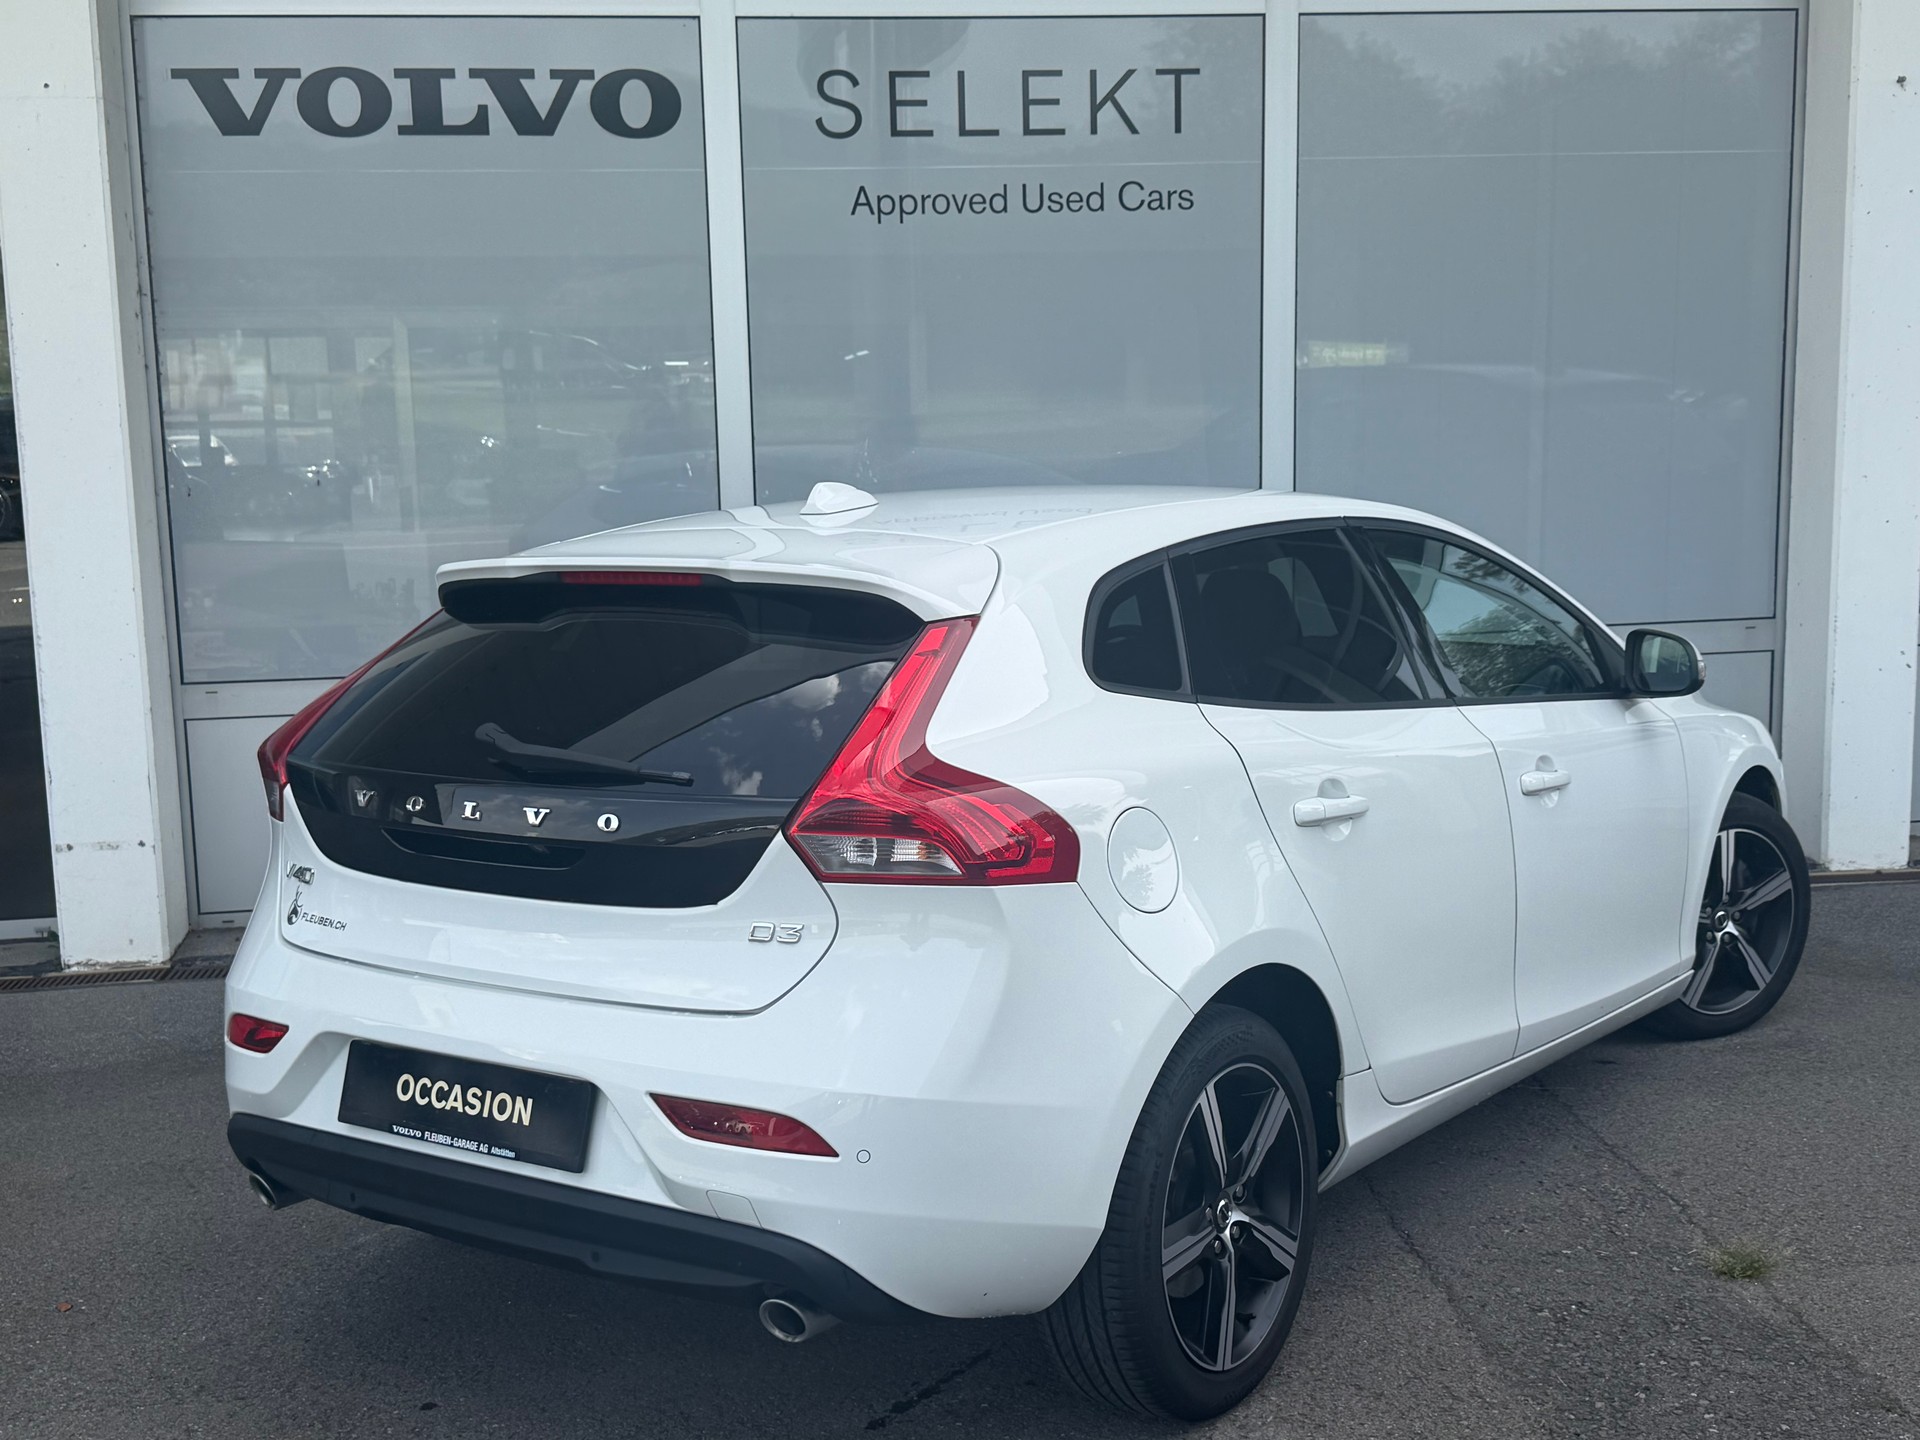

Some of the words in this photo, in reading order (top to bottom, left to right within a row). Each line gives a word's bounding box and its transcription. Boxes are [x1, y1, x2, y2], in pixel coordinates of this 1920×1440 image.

[170, 66, 682, 139] VOLVO
[815, 68, 1200, 139] SELEKT
[851, 184, 1007, 224] Approved
[1021, 183, 1105, 213] Used
[1118, 180, 1194, 212] Cars
[354, 789, 620, 832] VOLVO
[286, 861, 315, 885] V40
[301, 912, 347, 931] FLEUBEN.CH
[748, 921, 803, 945] D3
[396, 1073, 533, 1126] OCCASION
[392, 1124, 422, 1138] VOLVO
[424, 1131, 479, 1151] FLEUBEN-GARAGE
[479, 1143, 489, 1153] AG
[491, 1146, 516, 1158] Altstätten
